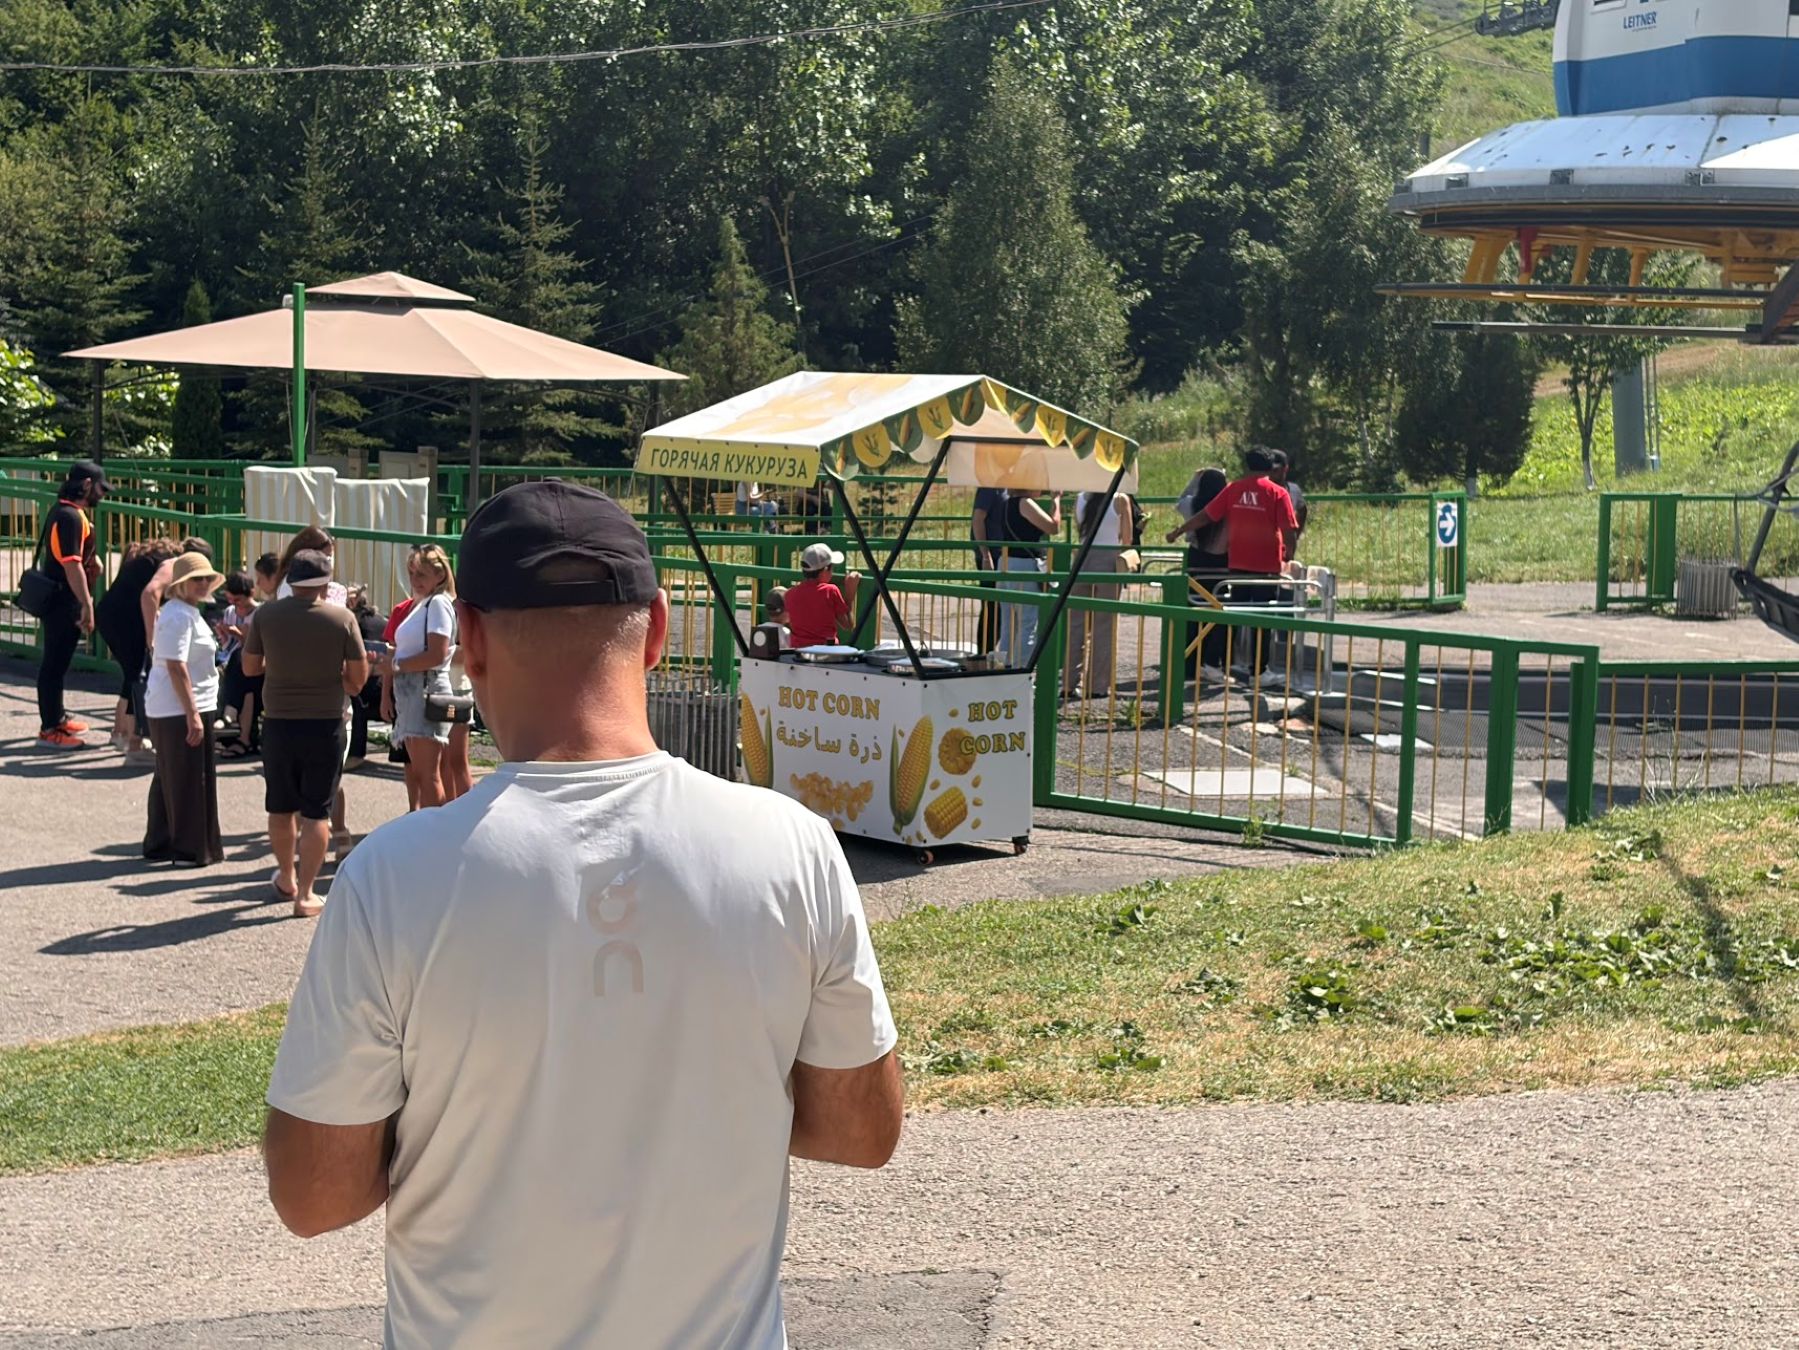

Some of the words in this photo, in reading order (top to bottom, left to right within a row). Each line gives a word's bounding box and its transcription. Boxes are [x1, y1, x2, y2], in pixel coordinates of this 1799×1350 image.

[1623, 11, 1657, 29] LEITNER
[650, 448, 720, 472] ГОРЯЧАЯ
[724, 453, 808, 479] КУКУРУЗА
[778, 686, 819, 712] HOT
[822, 692, 881, 721] CORN
[968, 699, 1018, 722] HOT
[776, 720, 841, 754] ساخنة
[849, 733, 882, 764] ذرة
[960, 731, 1026, 755] CORN
